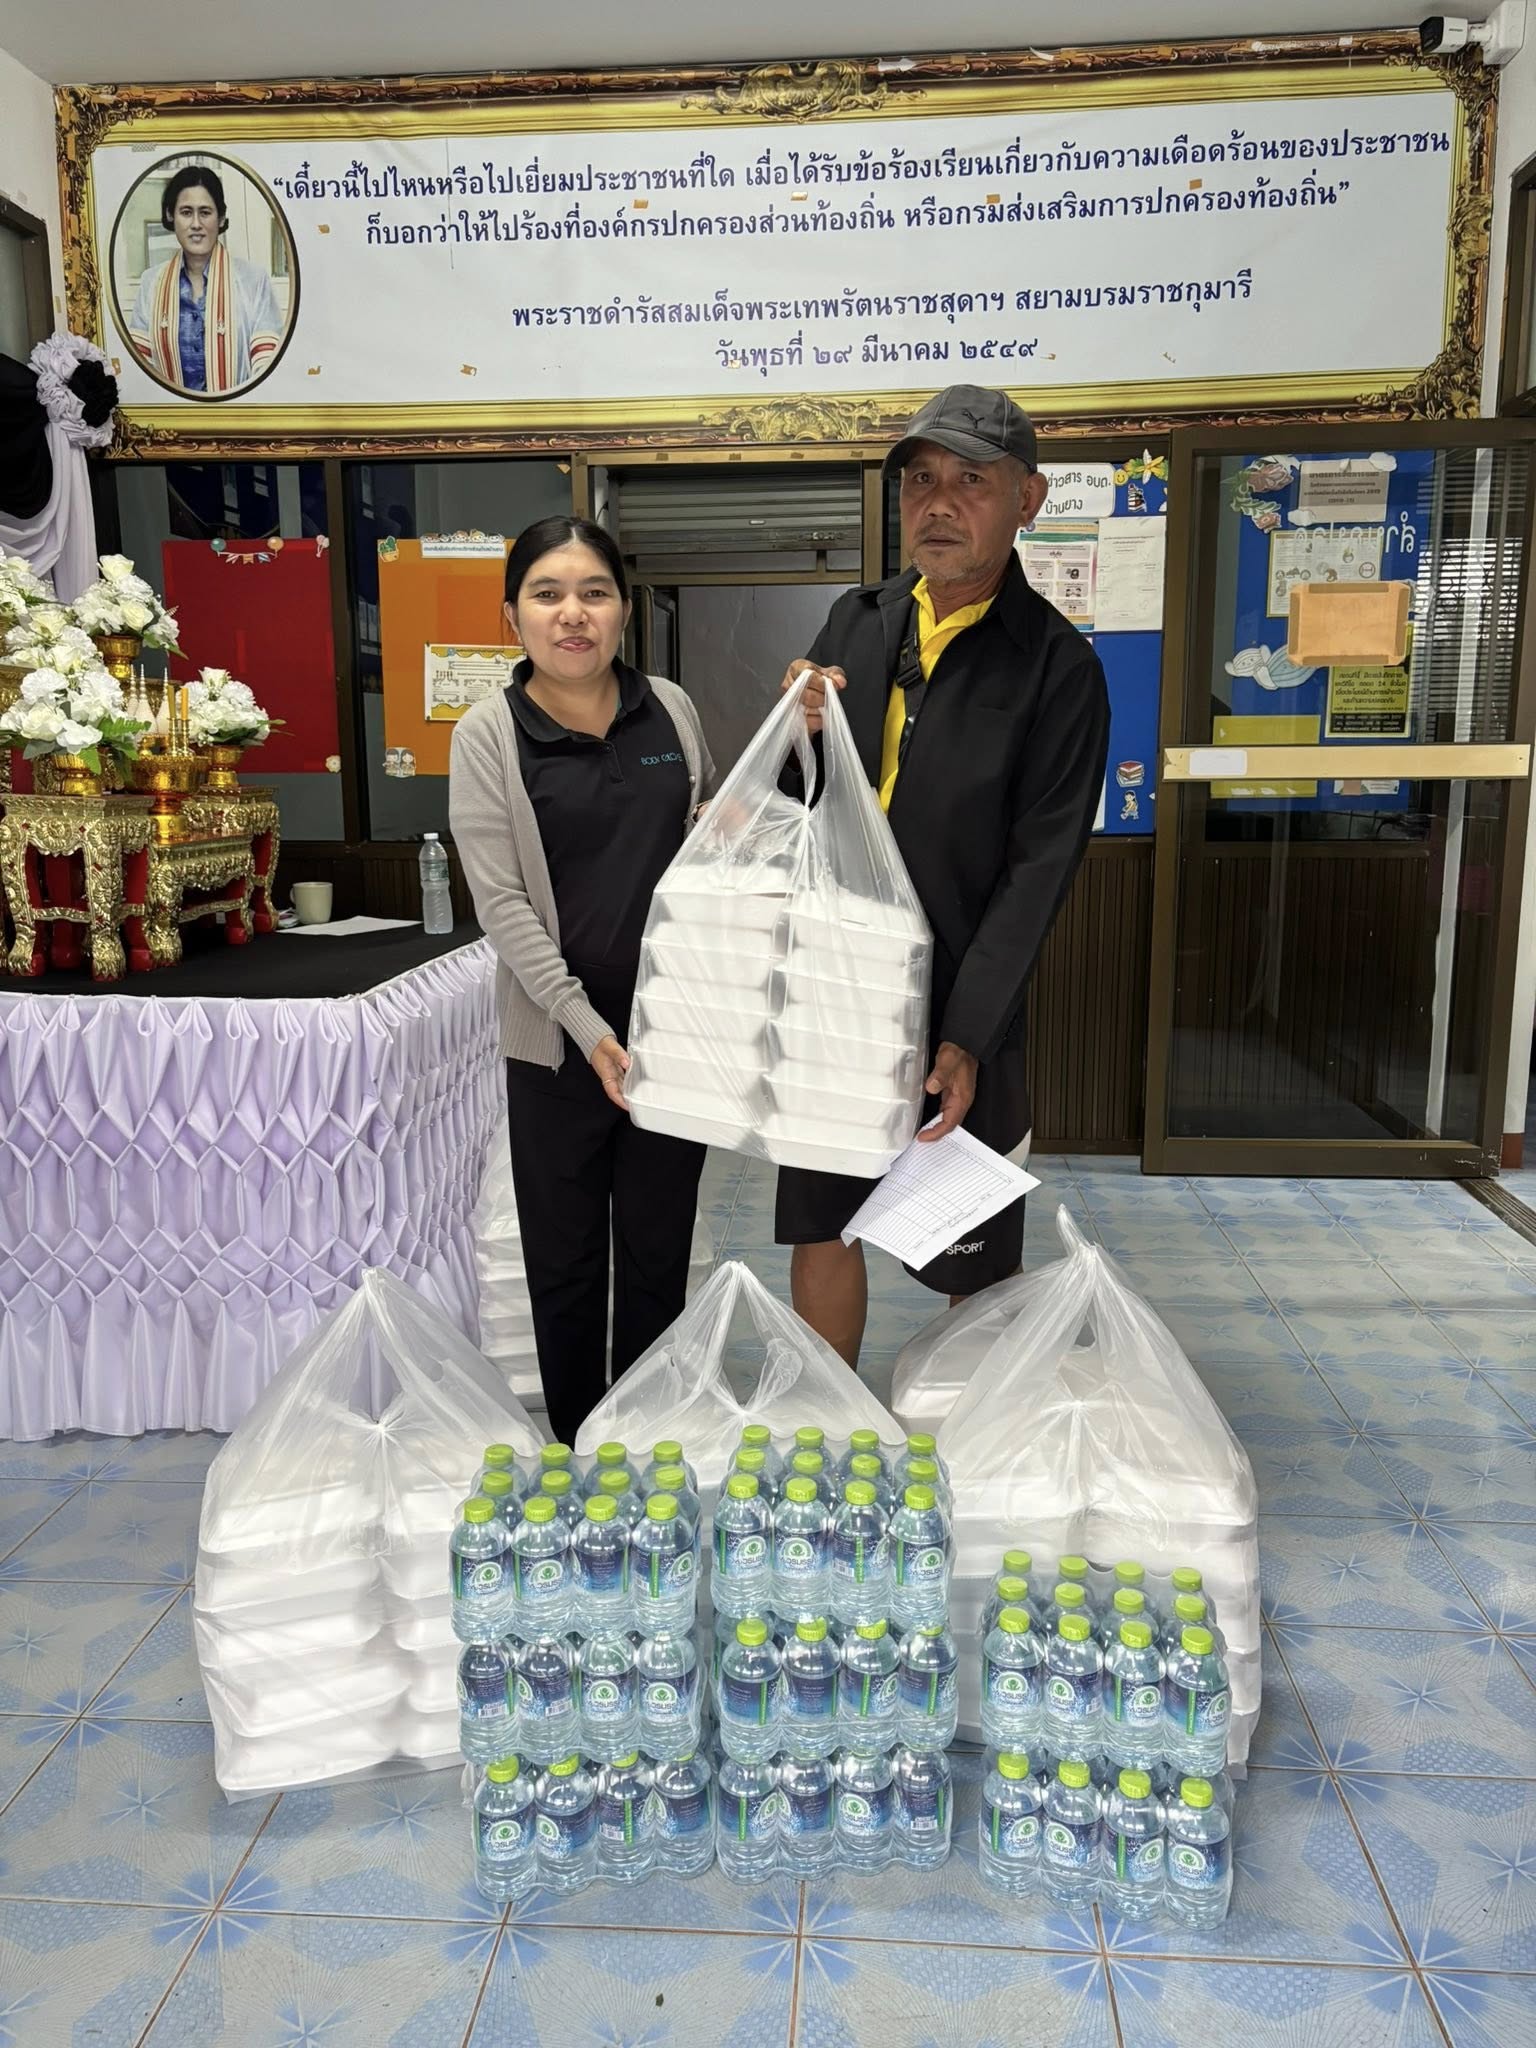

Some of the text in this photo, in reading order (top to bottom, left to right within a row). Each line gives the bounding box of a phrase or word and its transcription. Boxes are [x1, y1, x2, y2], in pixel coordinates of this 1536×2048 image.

[746, 128, 1450, 186] เมื่อได้รับข้อร้องเรียนเกี่ยวกับความเดือดร้อนของประชาชน
[366, 191, 895, 245] ก็บอกว่าให้ไปร้องที่องค์กรปกครองส่วนท้องถิ่น
[512, 268, 1253, 327] พระราชดำรัสสมเด็จพระเทพรัตนราชสุดาฯ สยามบรมราชกุมารี
[715, 329, 1038, 377] วันพุธที่ ๒๙ มีนาคม ๒๕๔๙
[1045, 499, 1083, 515] บ้านยาง
[946, 1241, 985, 1256] SPORT
